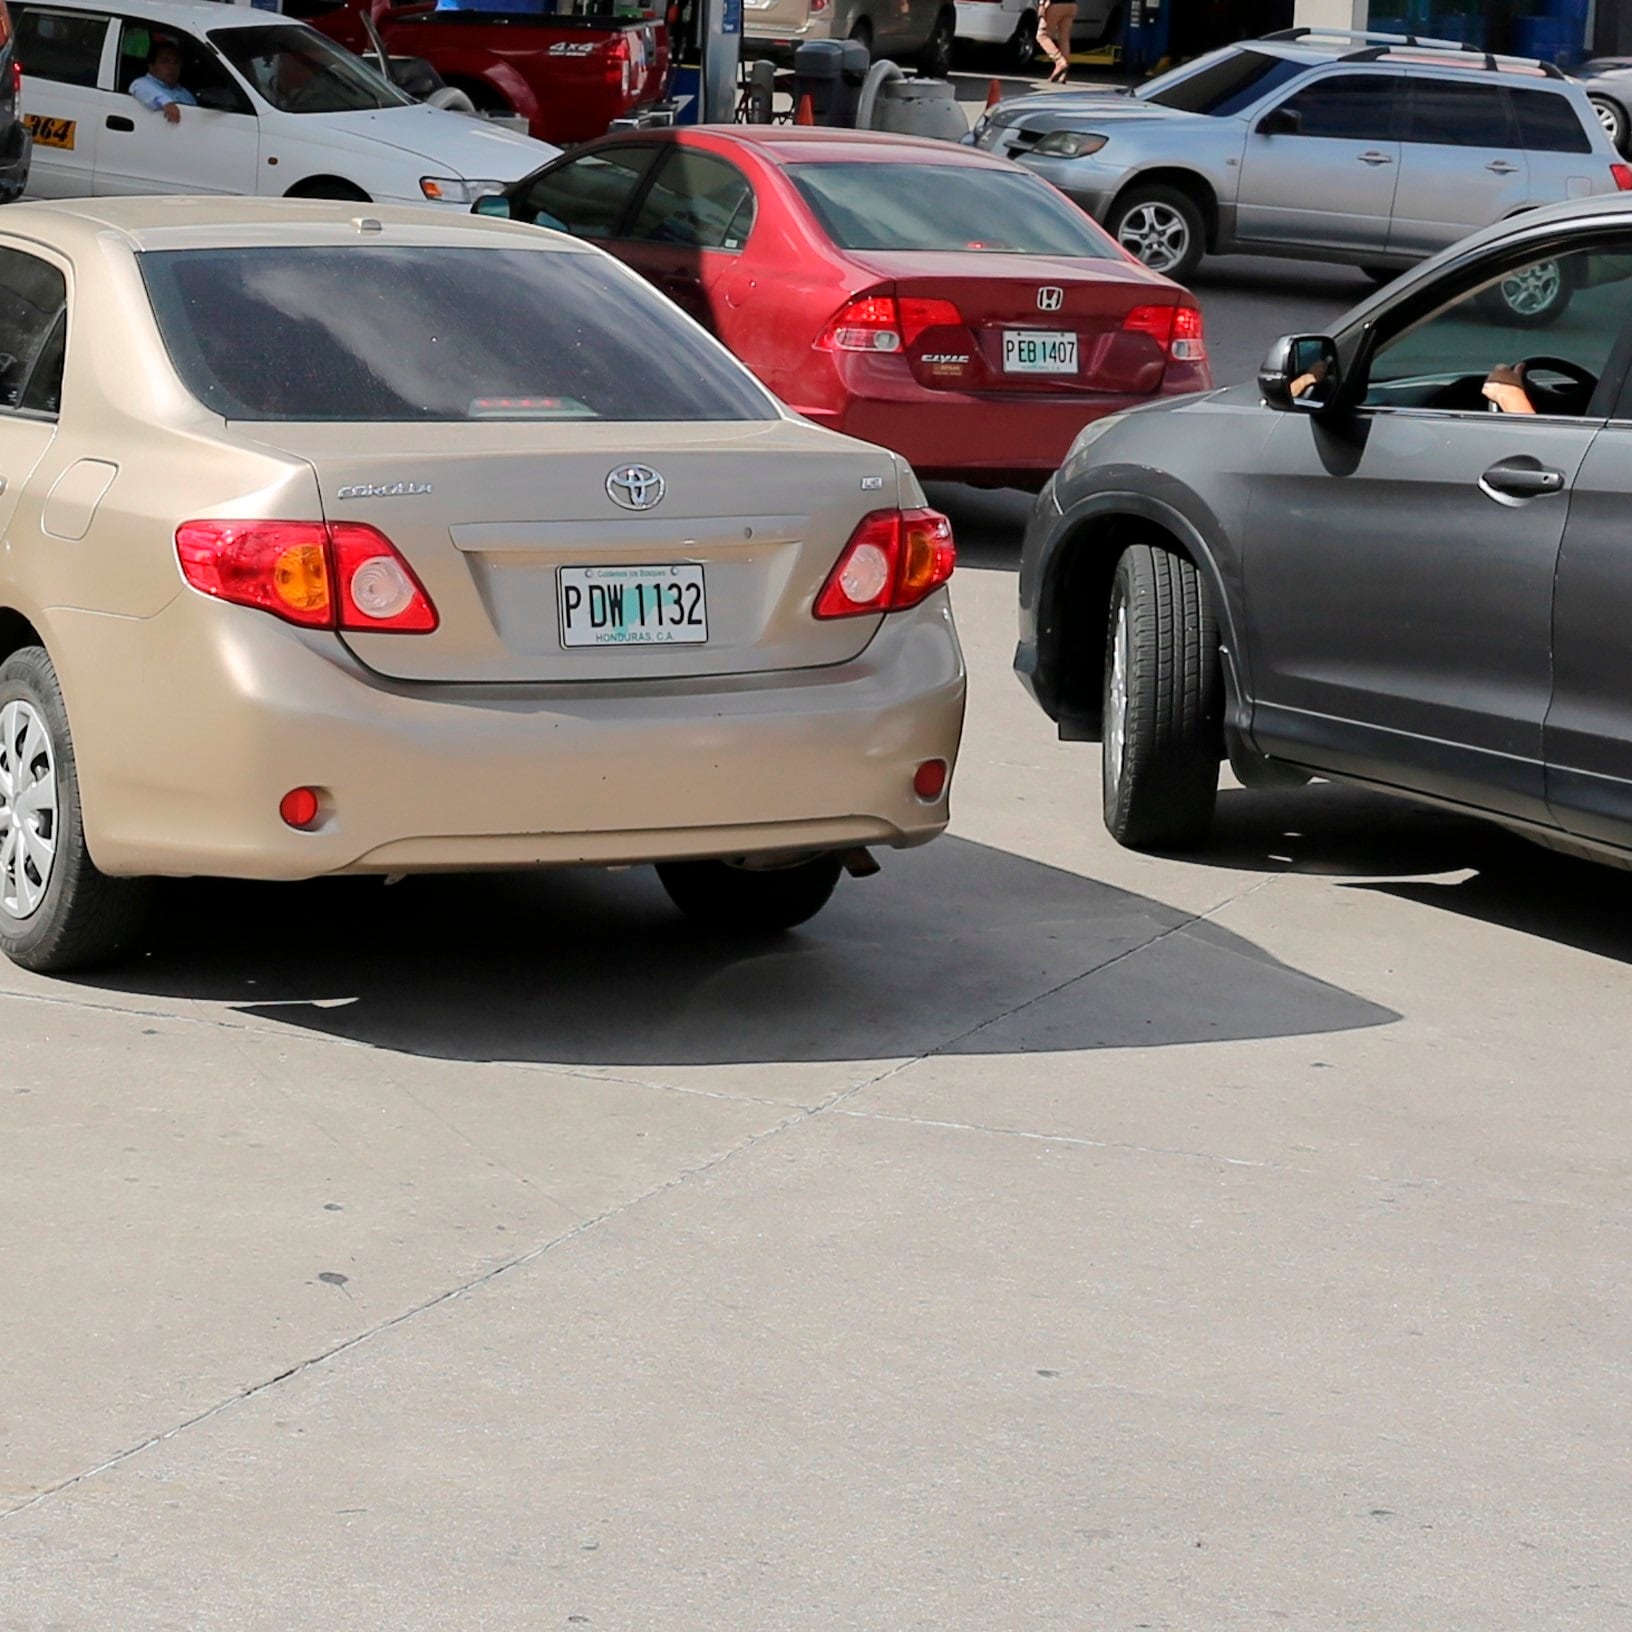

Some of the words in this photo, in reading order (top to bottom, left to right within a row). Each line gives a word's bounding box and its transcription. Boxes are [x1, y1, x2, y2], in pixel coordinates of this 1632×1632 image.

[921, 354, 970, 364] CIVIC
[1006, 339, 1015, 362] P
[1019, 340, 1037, 363] EB
[1041, 341, 1076, 364] 1407
[564, 585, 582, 628] P
[588, 583, 624, 628] DW
[635, 582, 703, 627] 1132
